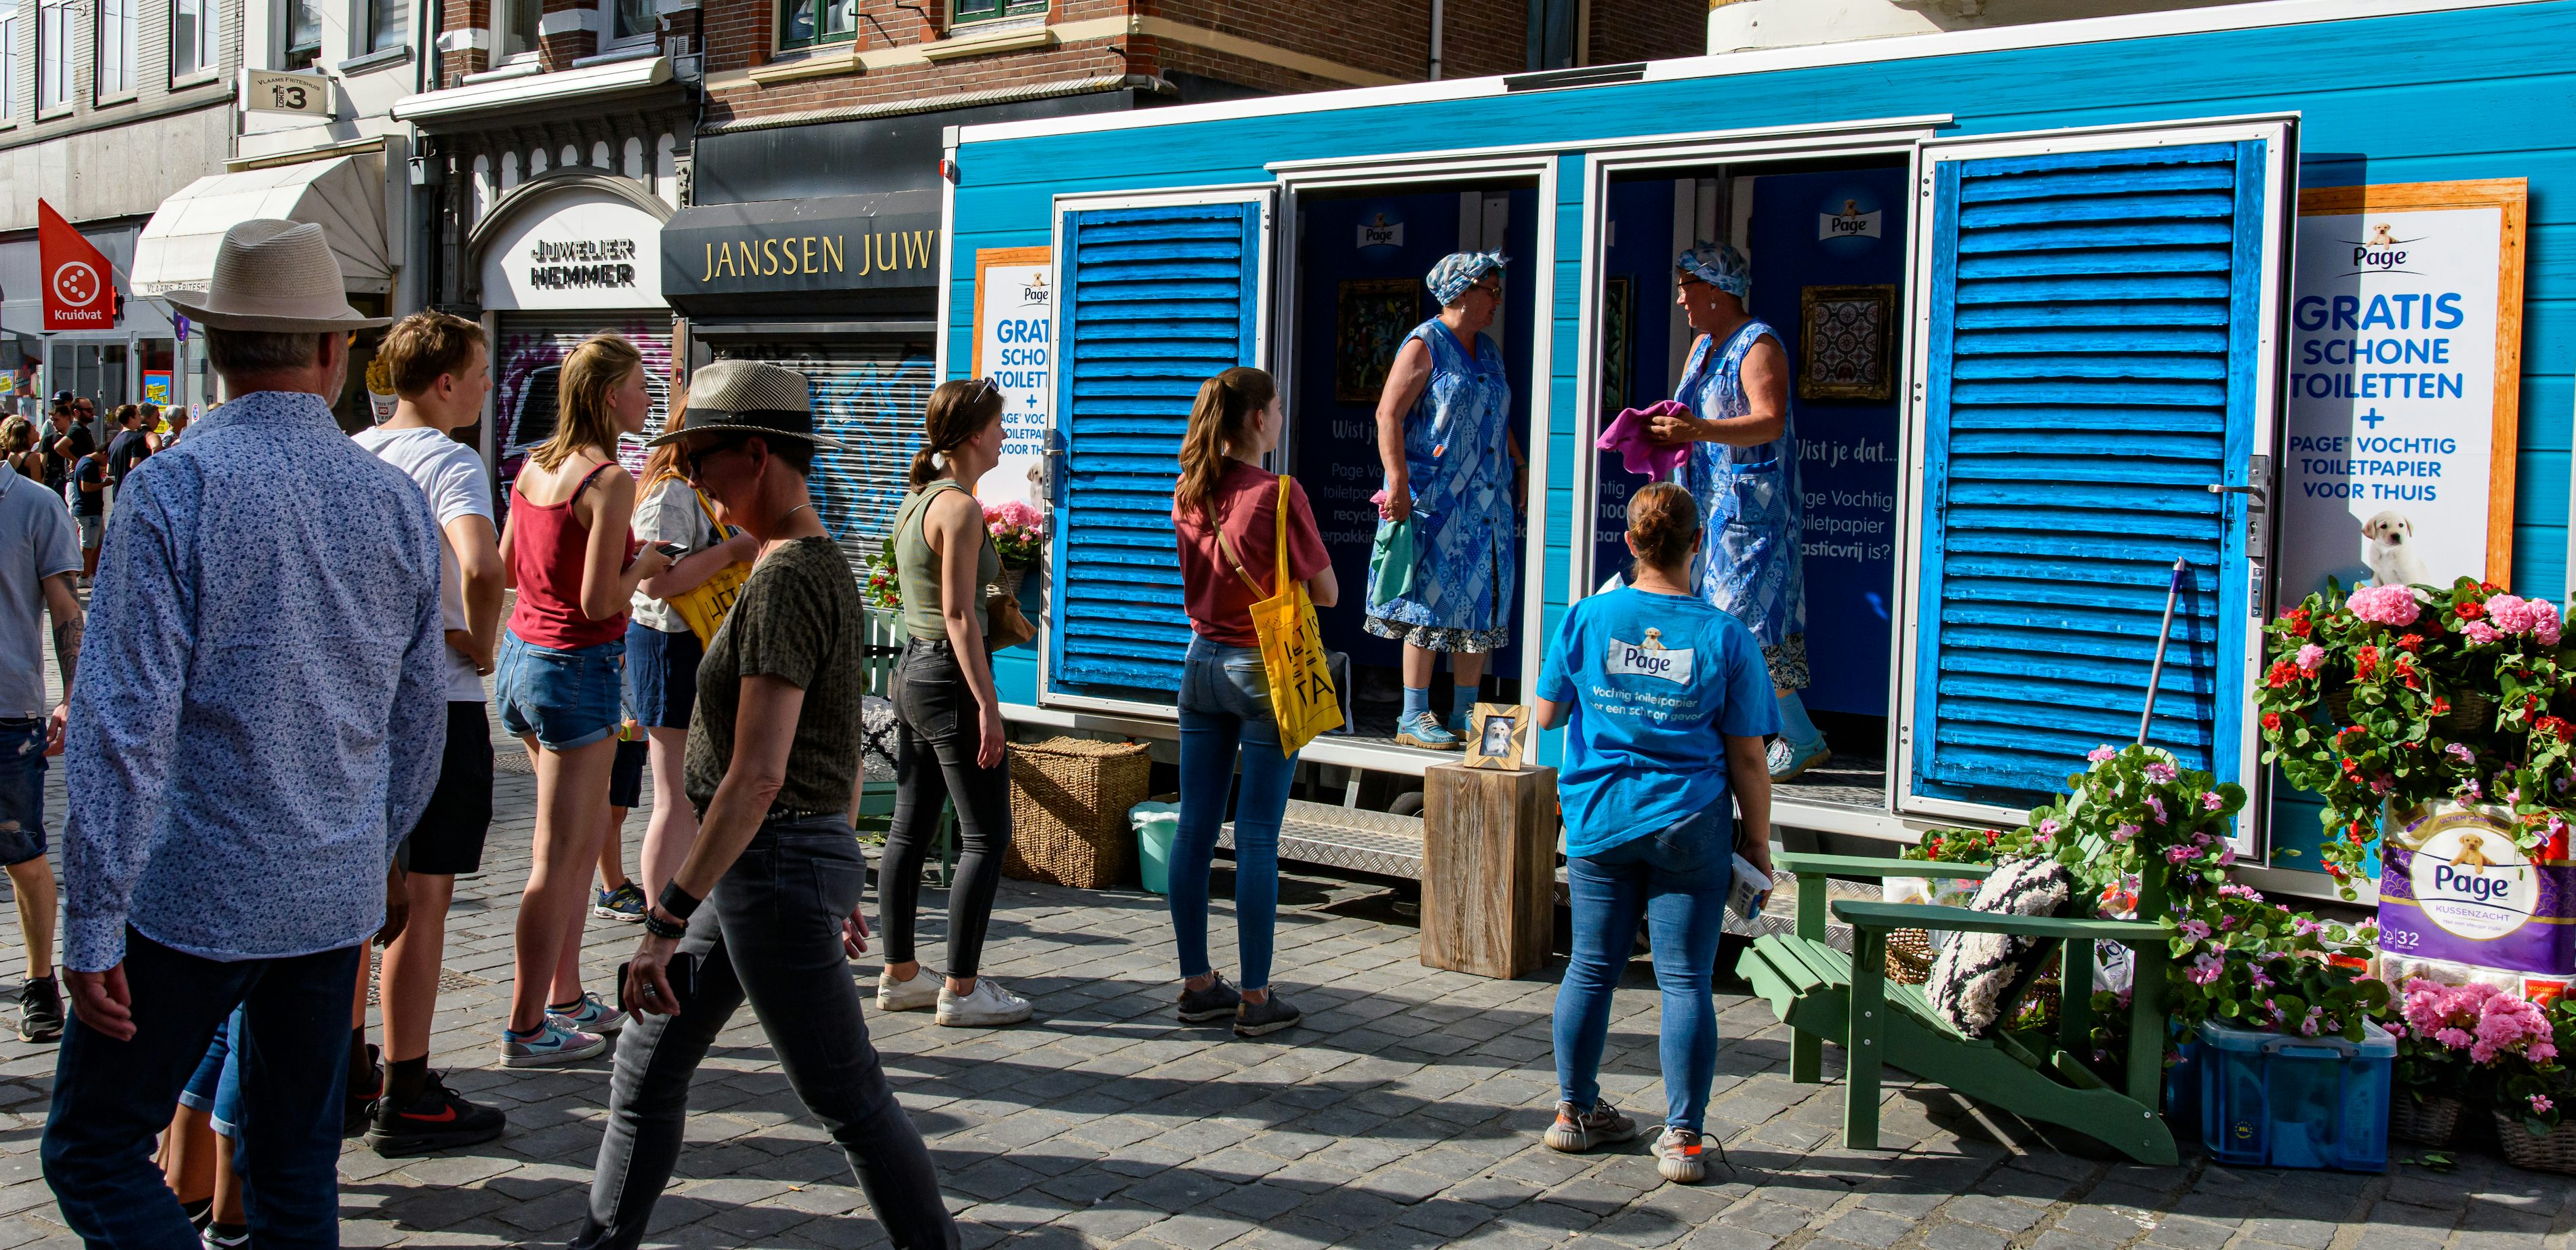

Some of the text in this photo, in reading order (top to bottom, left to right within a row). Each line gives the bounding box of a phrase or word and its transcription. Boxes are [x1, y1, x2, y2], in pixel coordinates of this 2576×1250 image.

[258, 77, 321, 92] VLAAMS FRITESHUIS
[1832, 217, 1867, 235] Page
[1365, 228, 1394, 243] Page
[531, 238, 635, 262] JUWELIER
[702, 229, 942, 283] JANSSEN JUW
[2353, 247, 2407, 270] Page
[531, 264, 635, 287] HEMMER
[147, 284, 173, 294] VLAAMS
[1024, 287, 1049, 303] Page
[54, 309, 102, 321] Kruidvat
[2293, 292, 2464, 332] GRATIS
[1001, 348, 1048, 366] SCHO
[2303, 338, 2450, 365] SCHONE
[2290, 373, 2463, 399] TOILETTEN
[1333, 419, 1364, 439] Wist
[1001, 444, 1028, 455] VOOR
[1830, 441, 1849, 468] je
[2356, 437, 2456, 454] VOCHTIG
[1332, 463, 1364, 481] Page
[2301, 458, 2441, 477] TOILETPAPIER
[1832, 489, 1893, 512] Vochtig
[2303, 482, 2436, 502] VOOR THUIS
[1868, 544, 1891, 561] is?
[1624, 647, 1671, 674] Page
[1592, 685, 1698, 709] Vochtig toiletpapier
[1605, 704, 1626, 714] een
[2440, 815, 2468, 825] ULTIEM
[2435, 865, 2509, 902] Page
[2436, 905, 2510, 922] KUSSENZACHT
[2466, 922, 2487, 930] vleugje
[2487, 924, 2501, 932] zijde
[2397, 930, 2419, 947] 32
